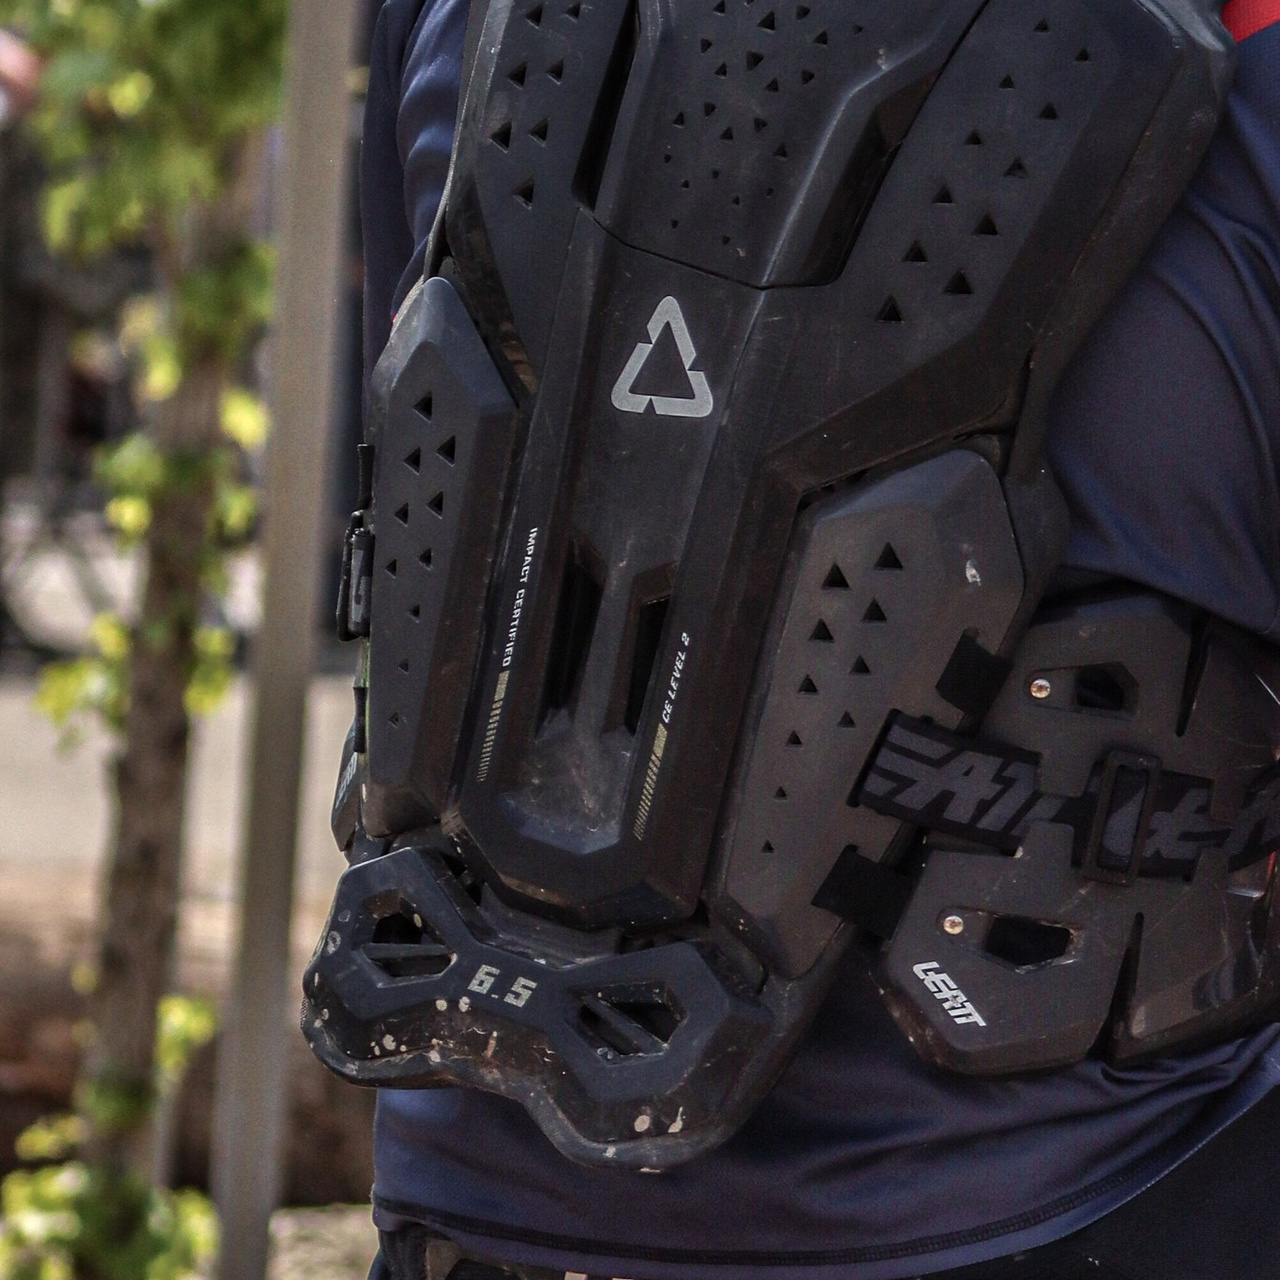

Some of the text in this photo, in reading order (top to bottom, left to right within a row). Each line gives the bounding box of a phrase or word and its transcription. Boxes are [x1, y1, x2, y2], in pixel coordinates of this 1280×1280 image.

[502, 527, 538, 667] IMPACT CERTIFIED
[661, 631, 691, 724] CE LEVEL 2
[467, 964, 538, 1008] 6.5
[912, 960, 987, 1028] LEATT
